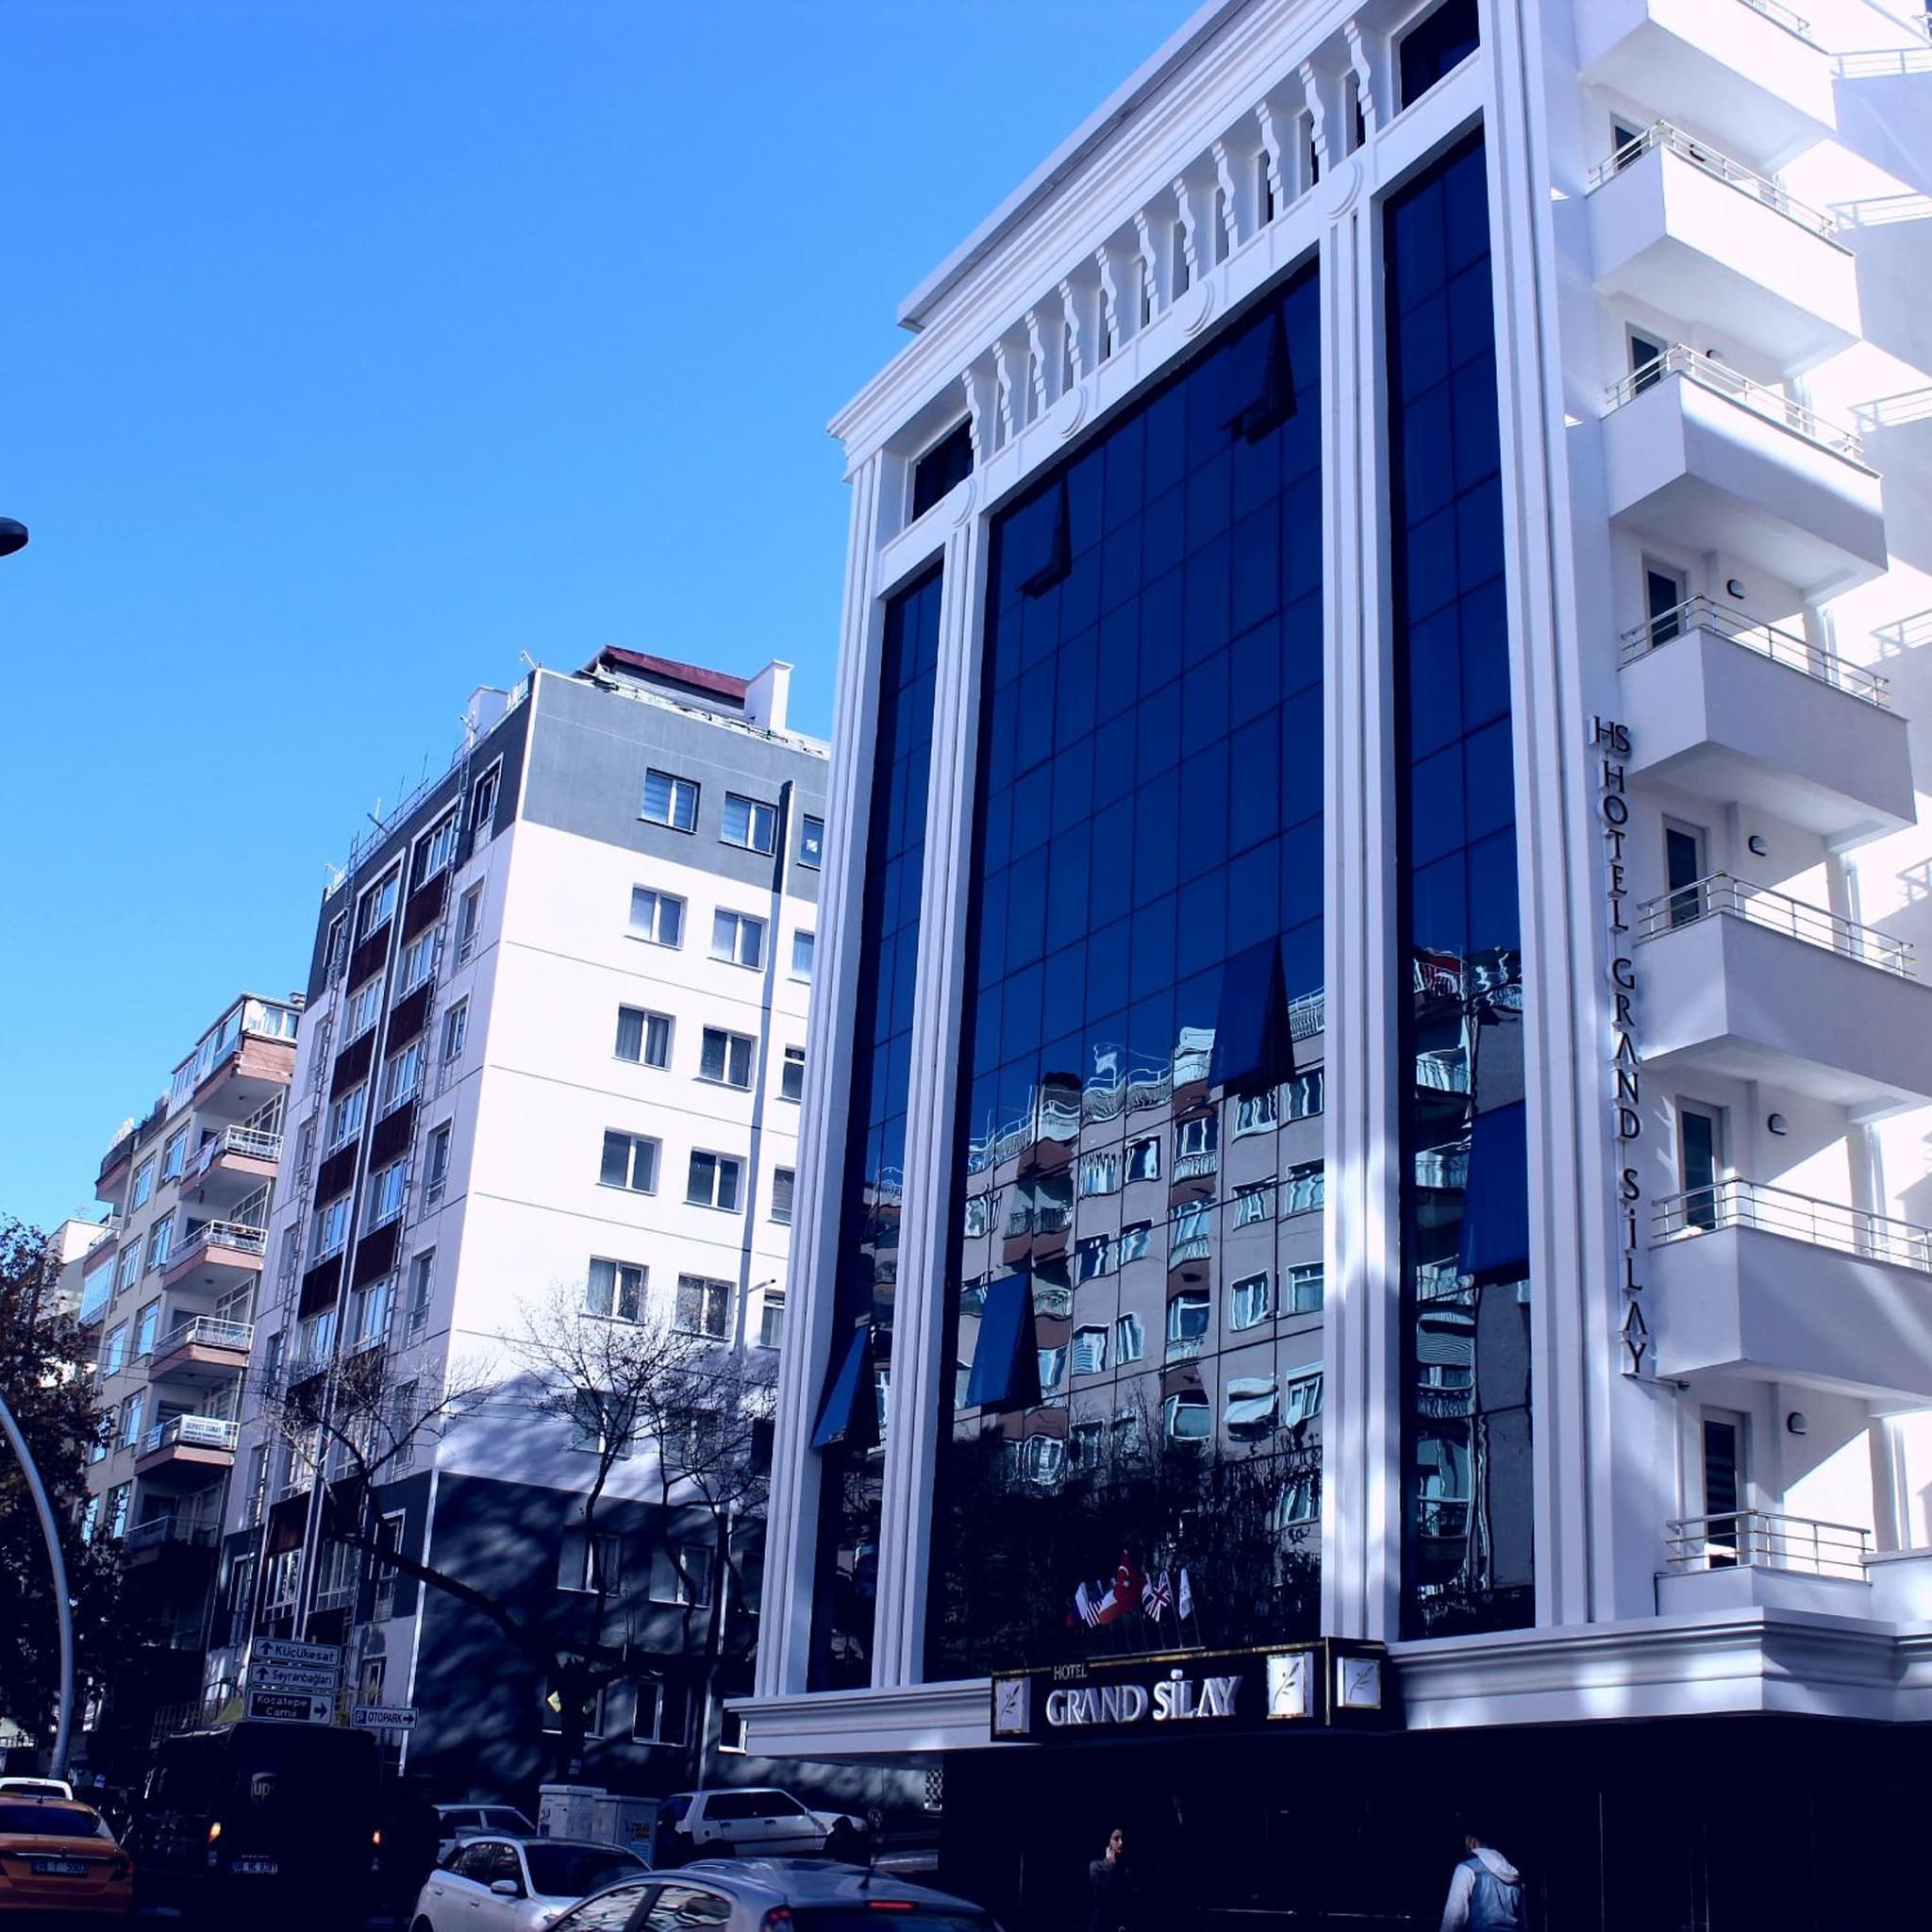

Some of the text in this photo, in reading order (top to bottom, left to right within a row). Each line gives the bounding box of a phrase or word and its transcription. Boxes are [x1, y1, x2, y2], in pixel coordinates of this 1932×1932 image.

[1591, 715, 1631, 755] HS
[1601, 759, 1629, 932] HOTEL
[1611, 958, 1641, 1141] GRAND
[1054, 1662, 1088, 1681] HOTEL
[368, 1711, 403, 1724] OTOPARK
[1046, 1684, 1148, 1726] GRAND
